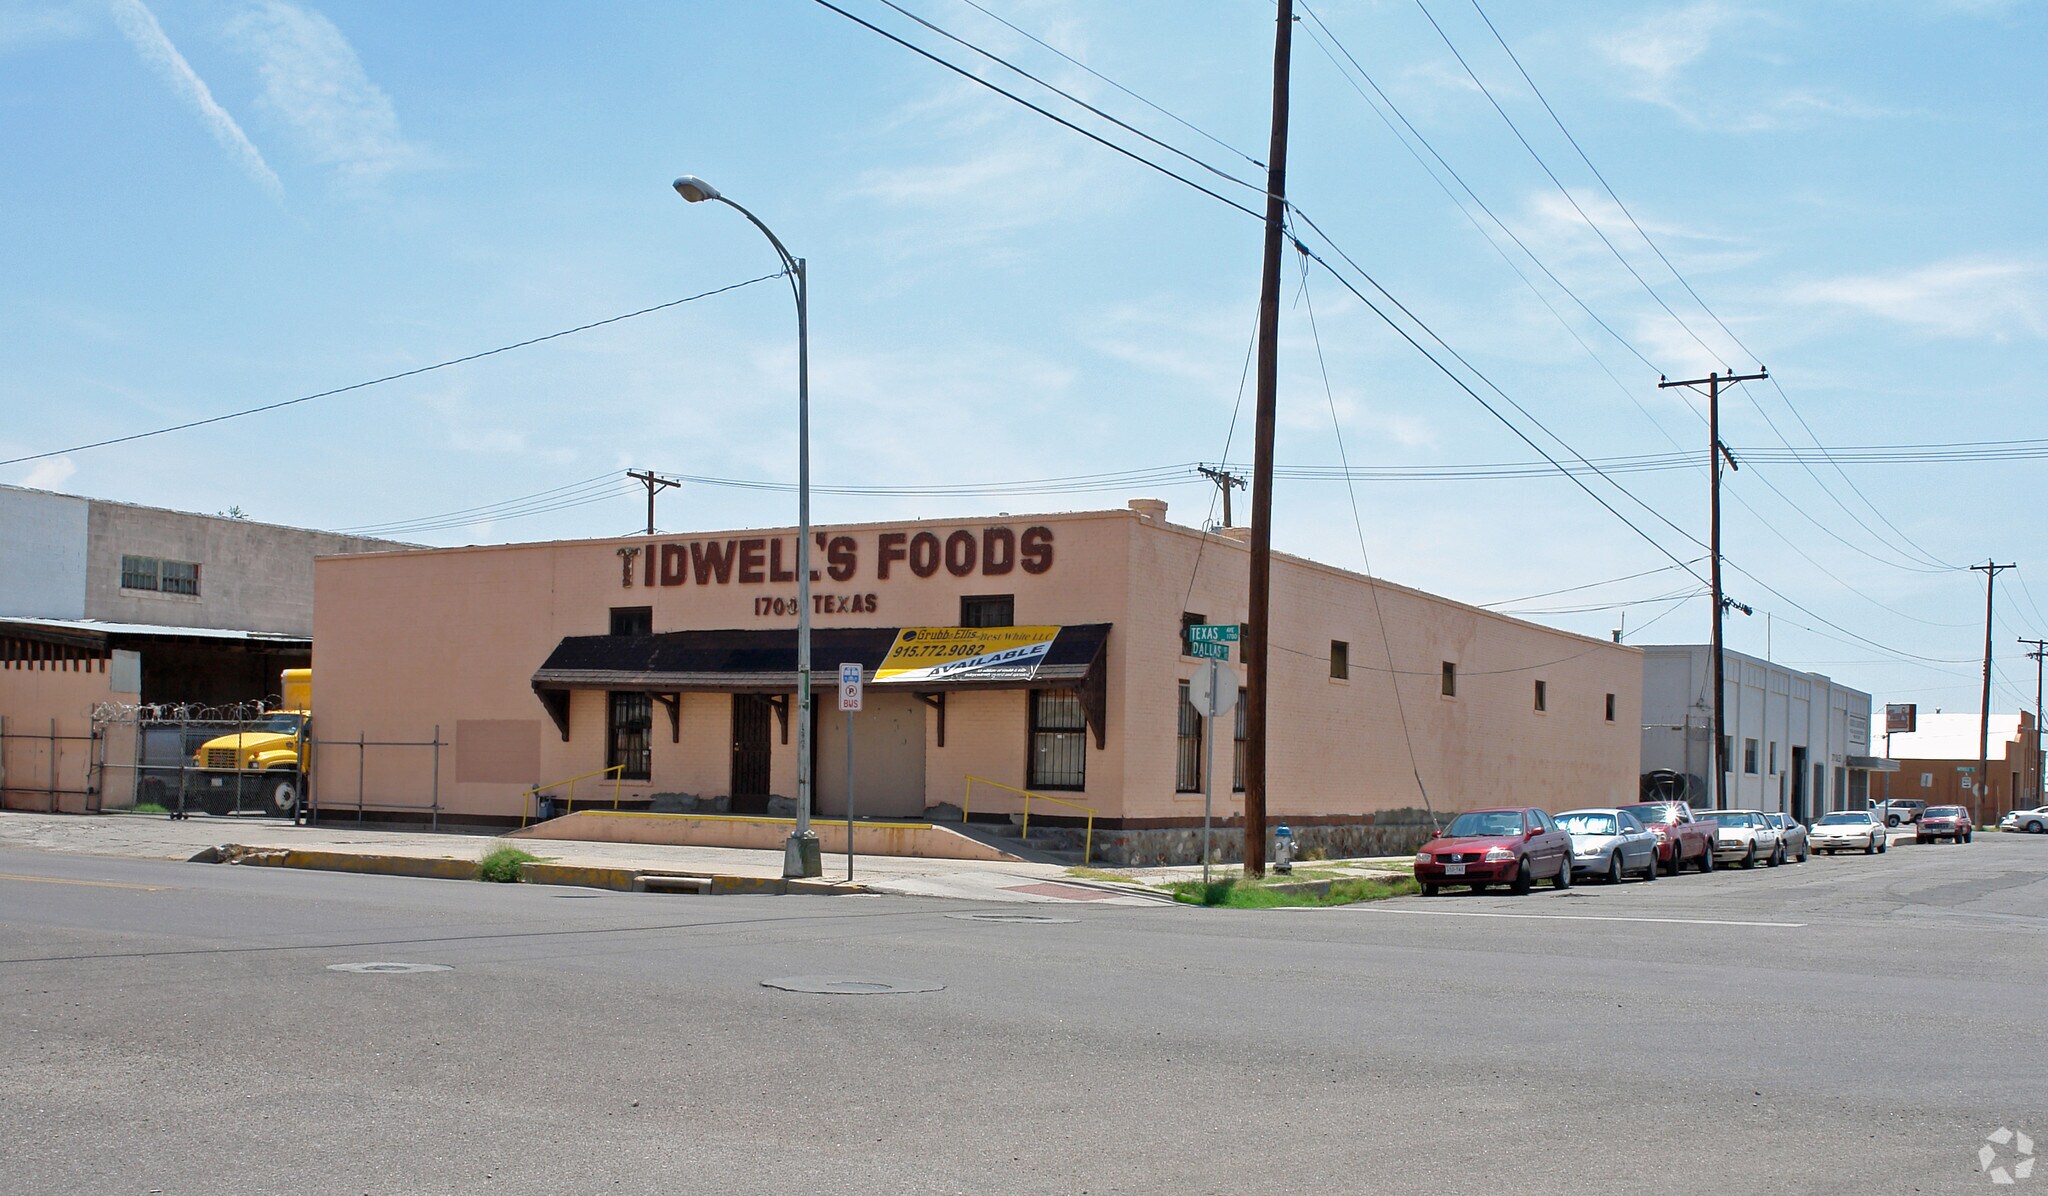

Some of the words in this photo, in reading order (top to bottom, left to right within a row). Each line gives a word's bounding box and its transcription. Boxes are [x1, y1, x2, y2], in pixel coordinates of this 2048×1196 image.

[877, 526, 1054, 580] FOODS
[812, 594, 878, 614] TEXAS
[917, 629, 949, 640] Grubb
[1032, 633, 1053, 641] LLC
[1191, 627, 1218, 639] TEXAS
[893, 644, 985, 658] 915.772.9082
[1193, 642, 1221, 657] DALLAS
[927, 645, 1045, 677] AVAILABLE
[843, 699, 859, 708] BUS
